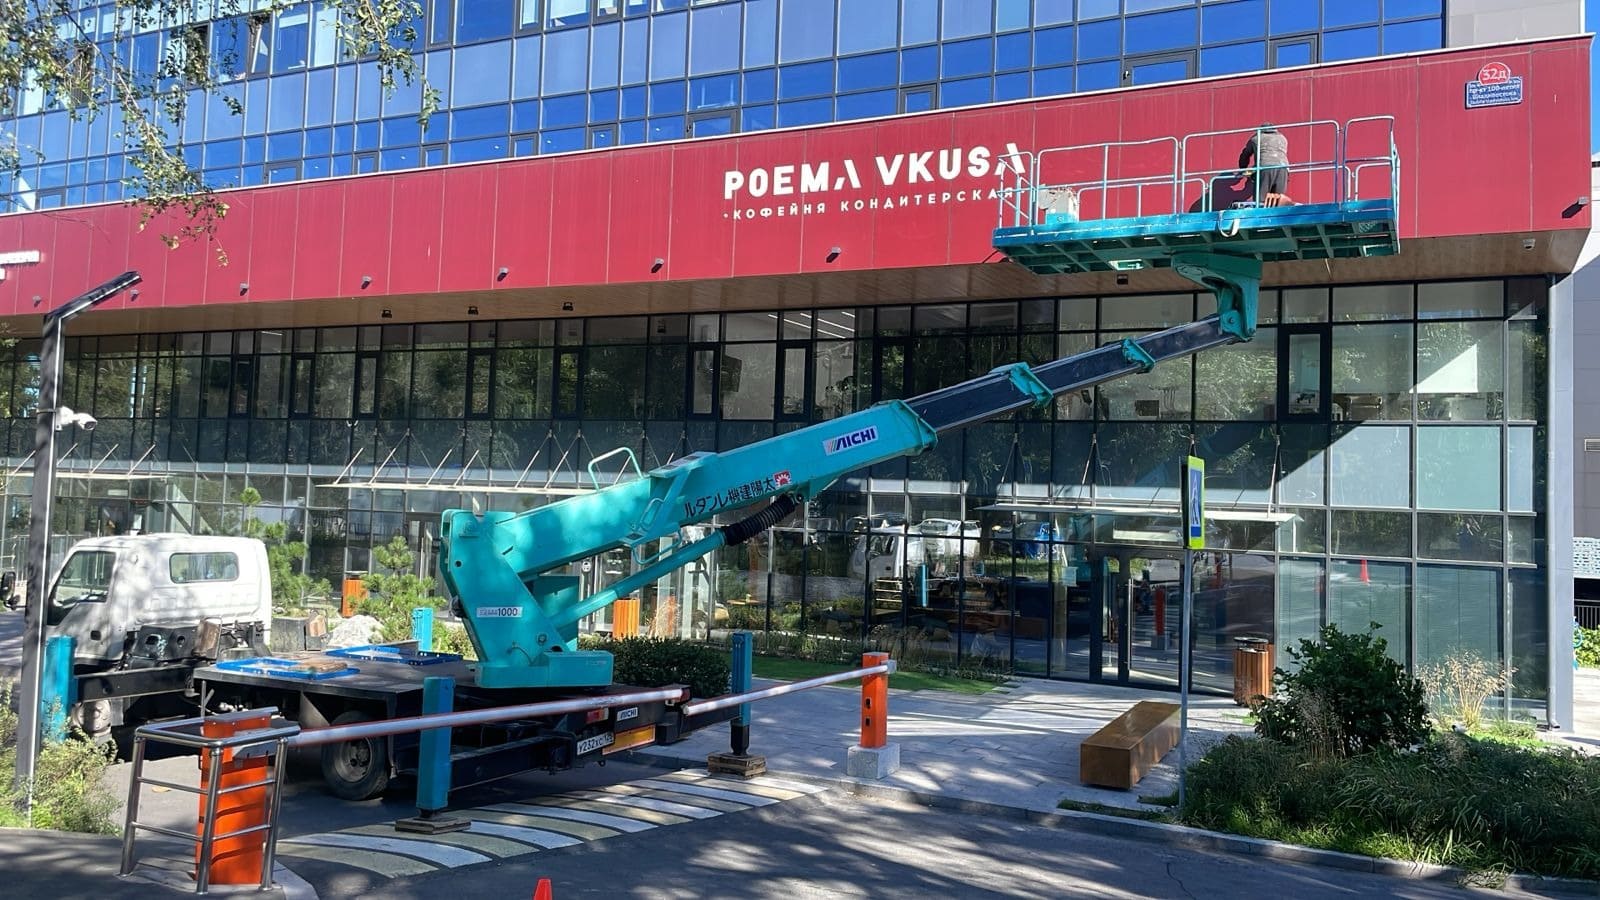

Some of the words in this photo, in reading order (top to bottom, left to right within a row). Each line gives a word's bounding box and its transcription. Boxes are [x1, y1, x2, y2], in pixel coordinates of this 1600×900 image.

[724, 159, 862, 200] POEMA
[875, 143, 1026, 186] VKUSA
[733, 202, 825, 220] КОФЕЙНЯ
[841, 187, 1013, 212] КОНДИТЕРСКАЯ
[834, 428, 876, 451] AICHI
[498, 607, 518, 616] 1000
[620, 708, 637, 719] AICHI
